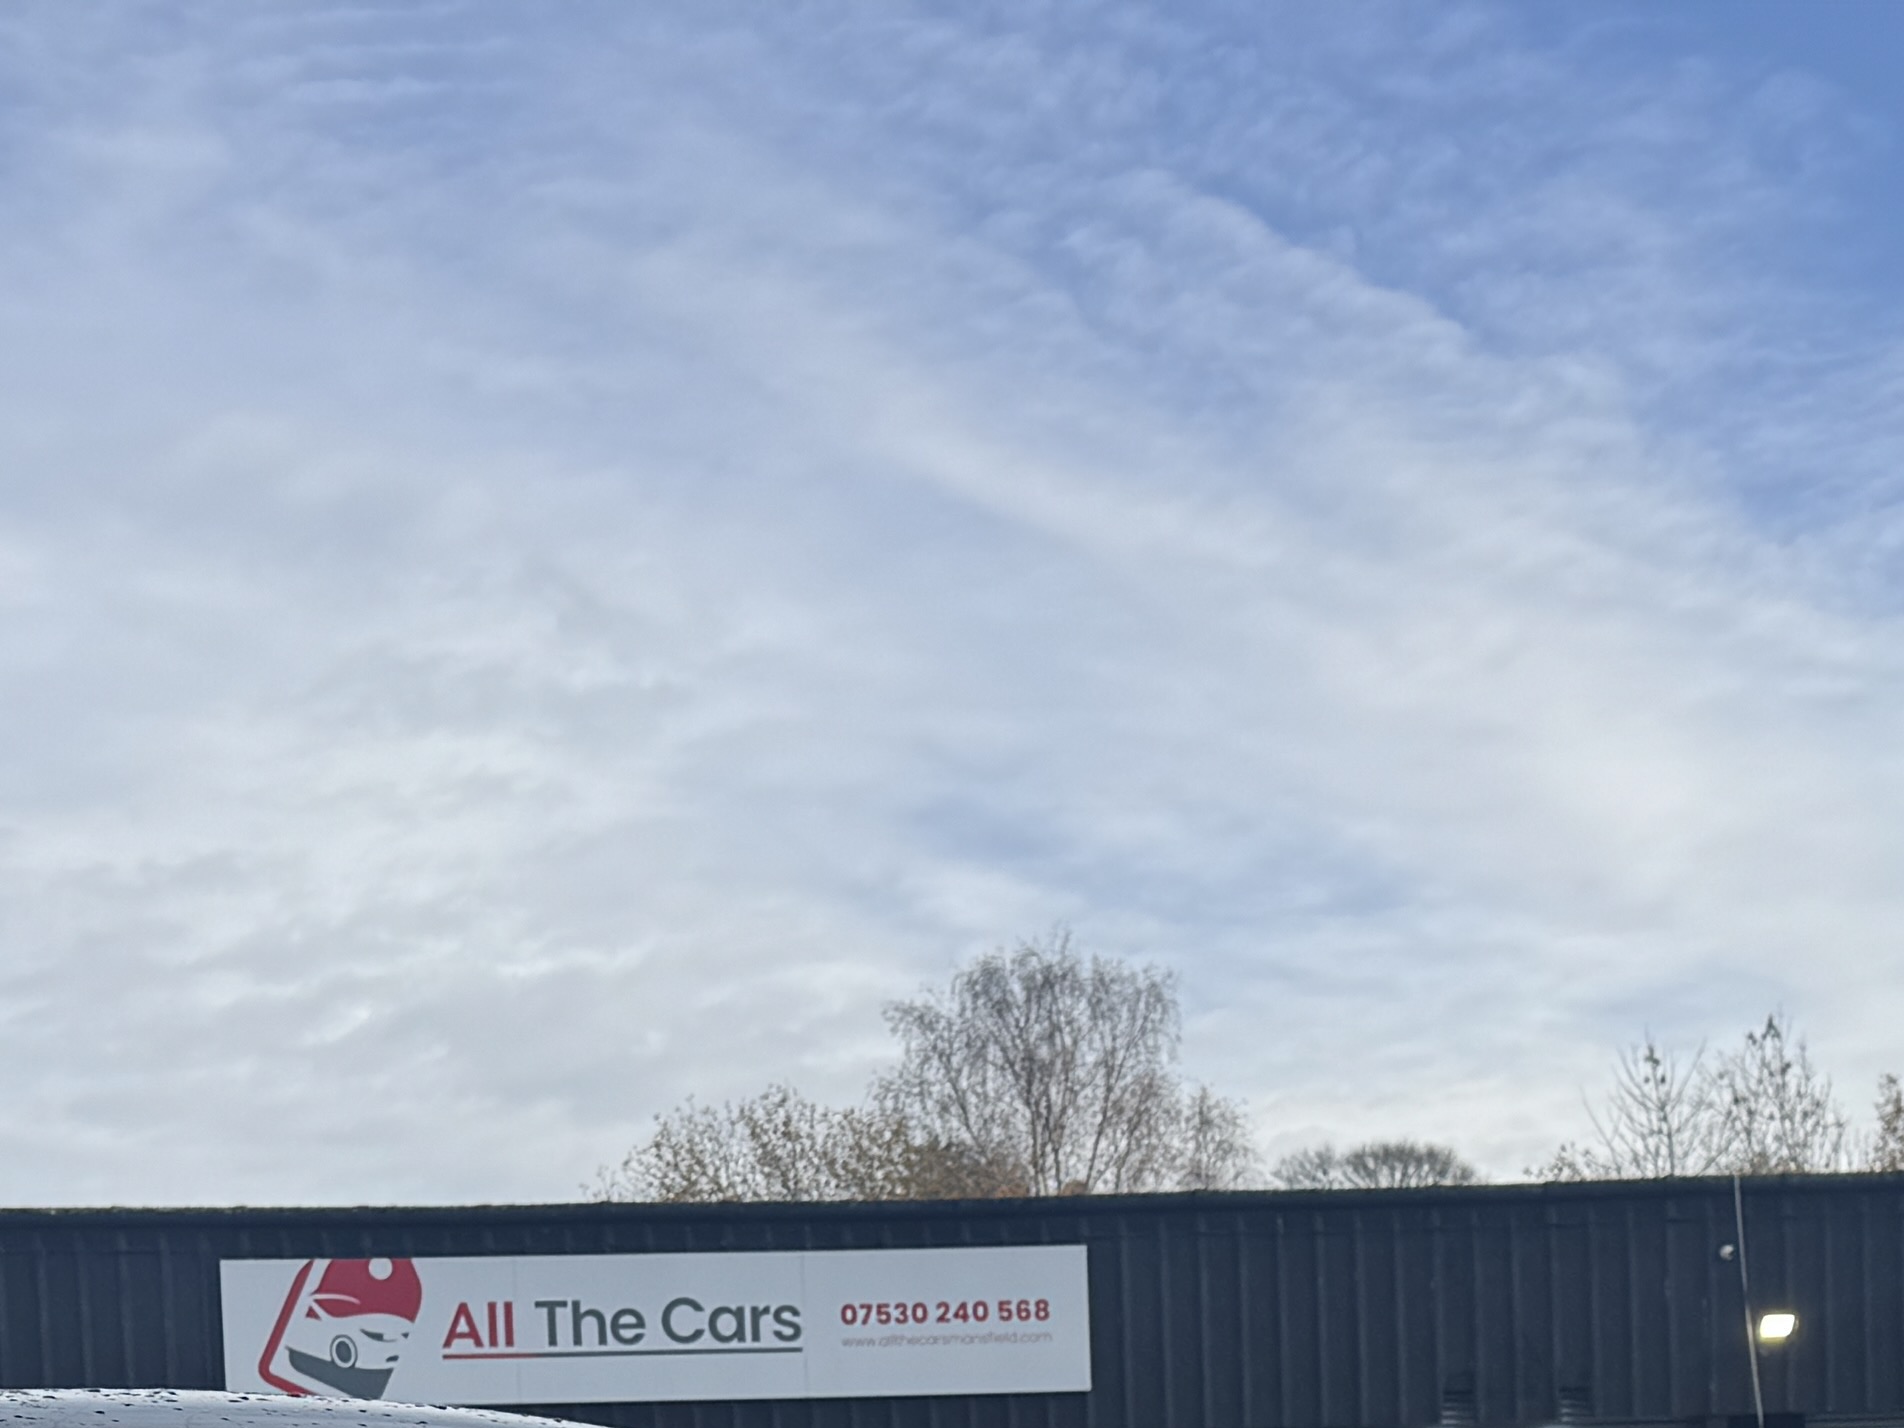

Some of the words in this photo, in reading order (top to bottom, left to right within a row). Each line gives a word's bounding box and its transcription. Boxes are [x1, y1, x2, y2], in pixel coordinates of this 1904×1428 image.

[442, 1302, 515, 1348] All
[534, 1300, 646, 1347] The
[661, 1297, 803, 1344] Cars
[840, 1302, 928, 1326] 07530
[935, 1301, 989, 1324] 240
[998, 1299, 1050, 1322] 568
